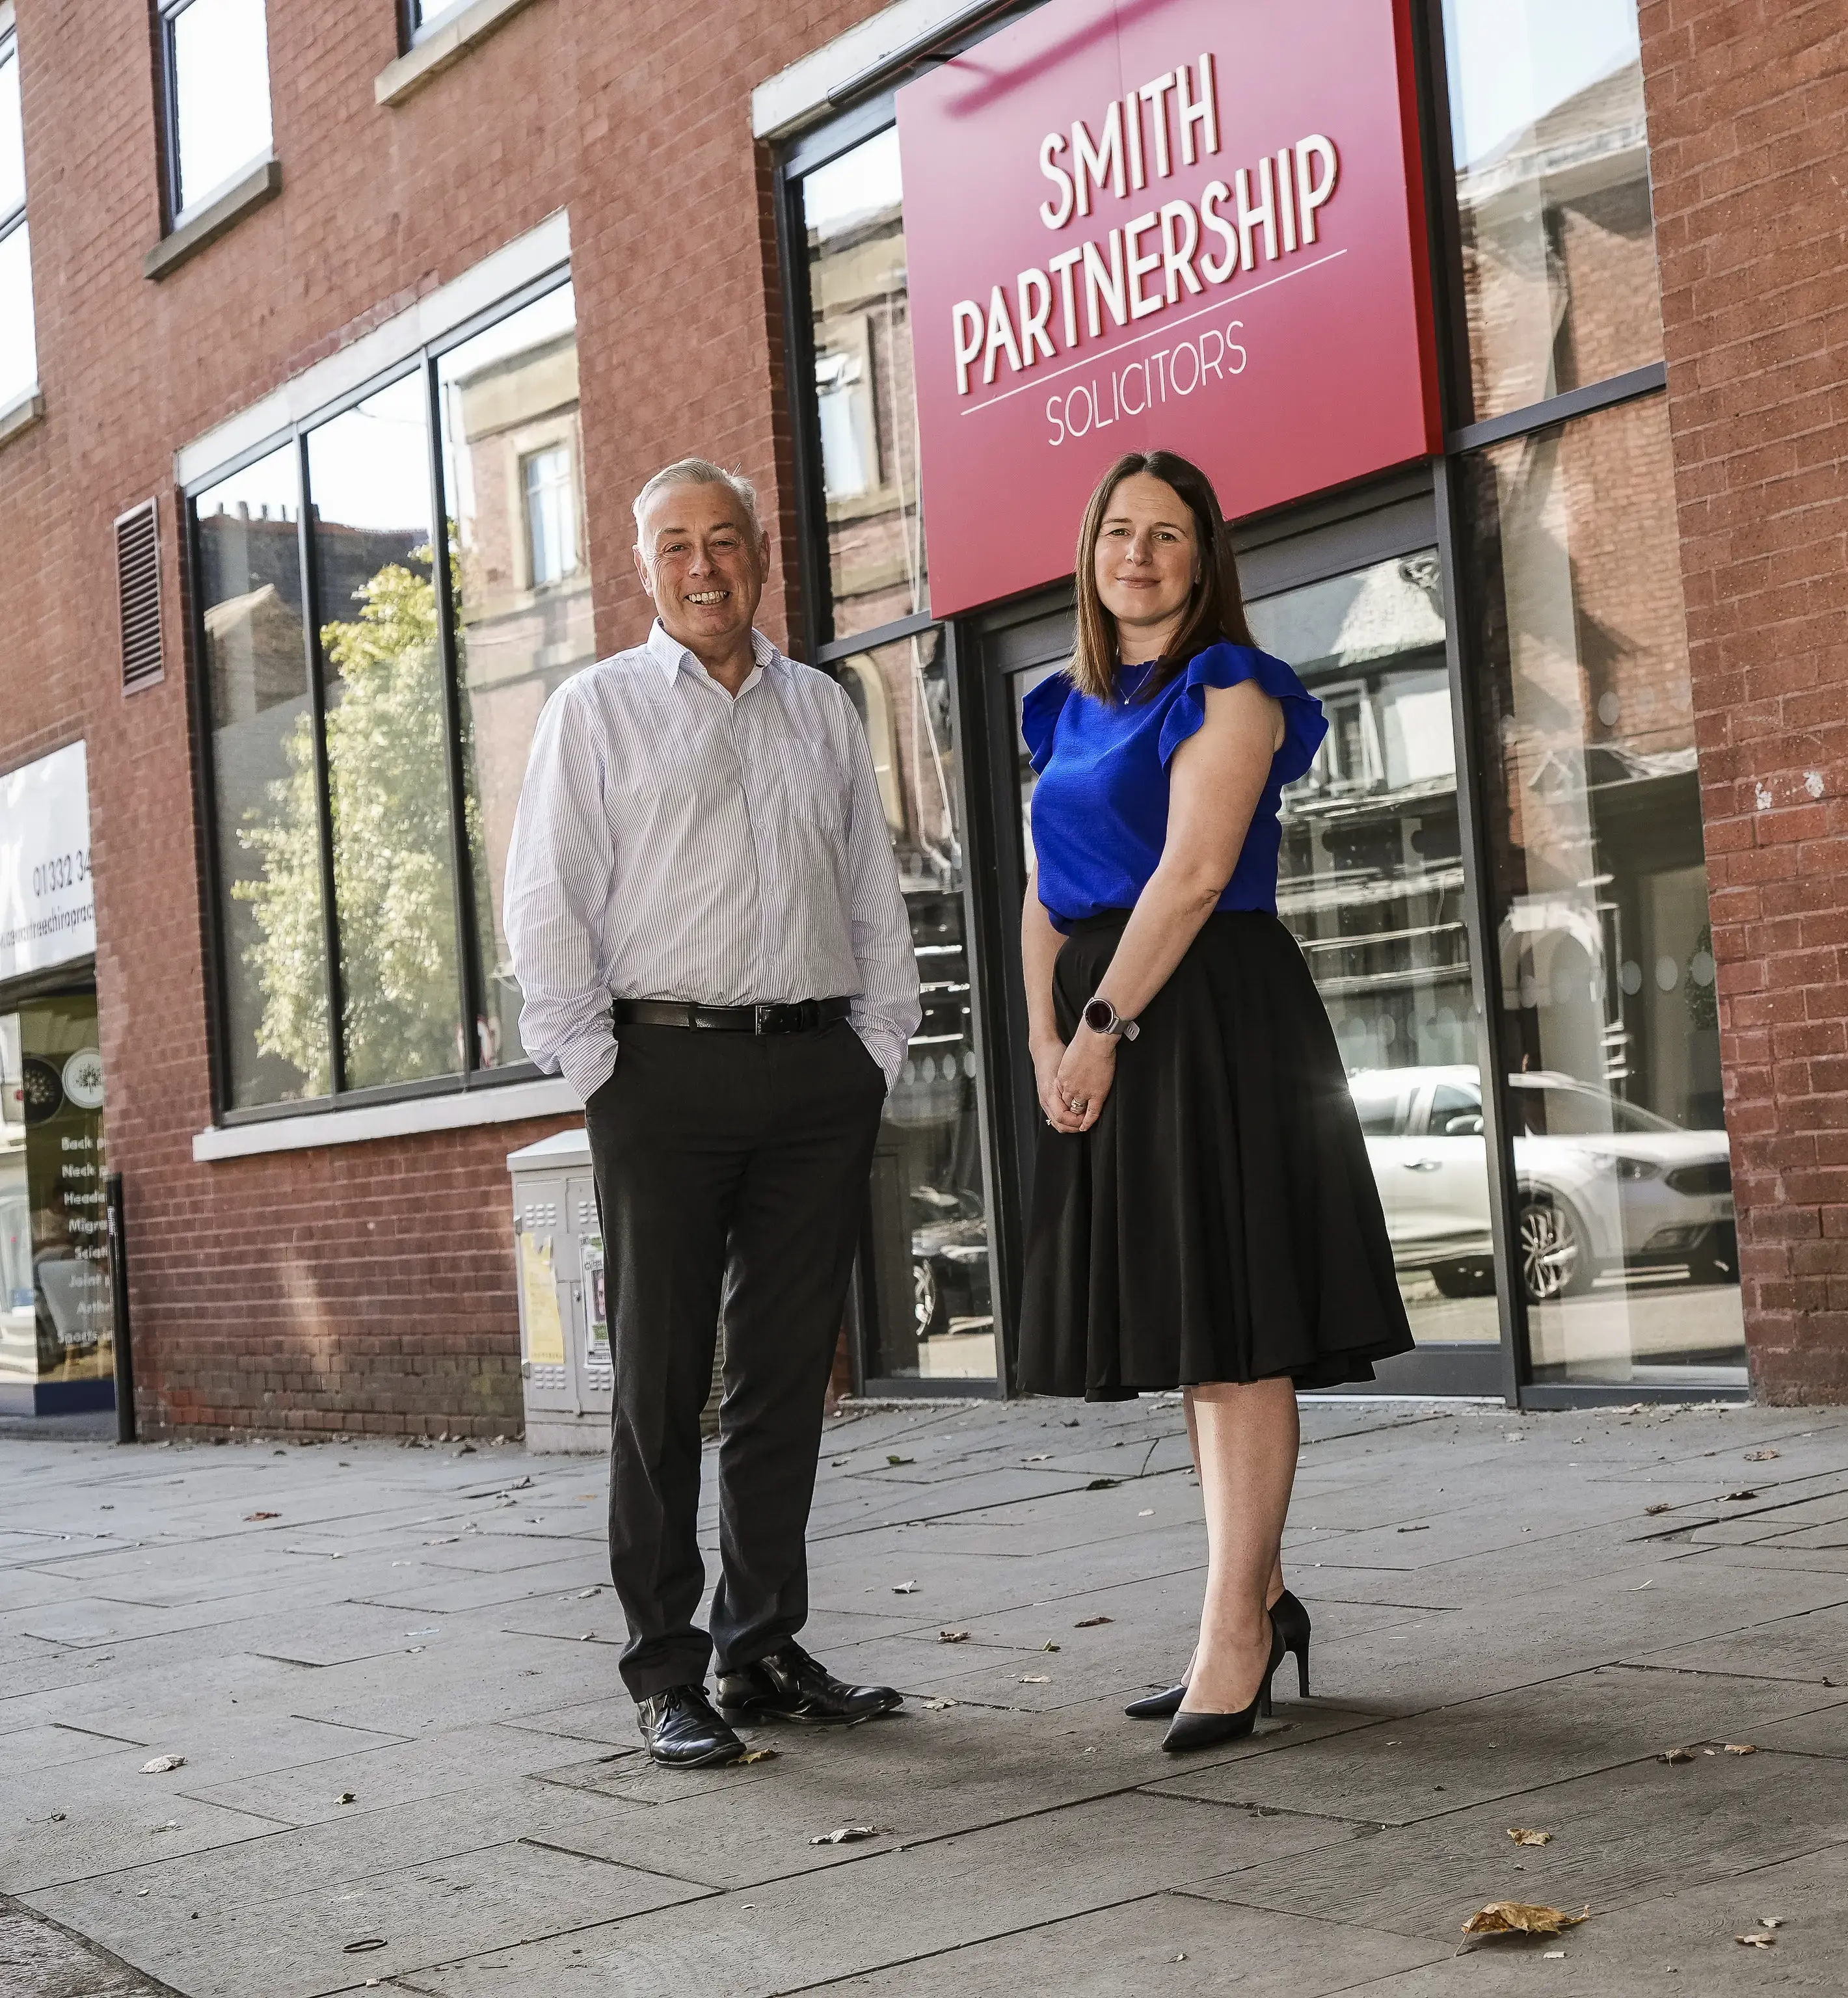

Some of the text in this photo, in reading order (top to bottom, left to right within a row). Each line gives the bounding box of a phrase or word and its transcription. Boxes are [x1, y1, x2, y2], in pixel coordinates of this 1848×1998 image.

[1039, 51, 1221, 230] SMITH
[952, 133, 1339, 395] PARTNERSHIP
[1045, 321, 1247, 446] SOLICITORS
[33, 854, 72, 897] 01332
[62, 1135, 93, 1150] Back
[62, 1162, 96, 1179] Neck
[69, 1273, 102, 1287] Joint
